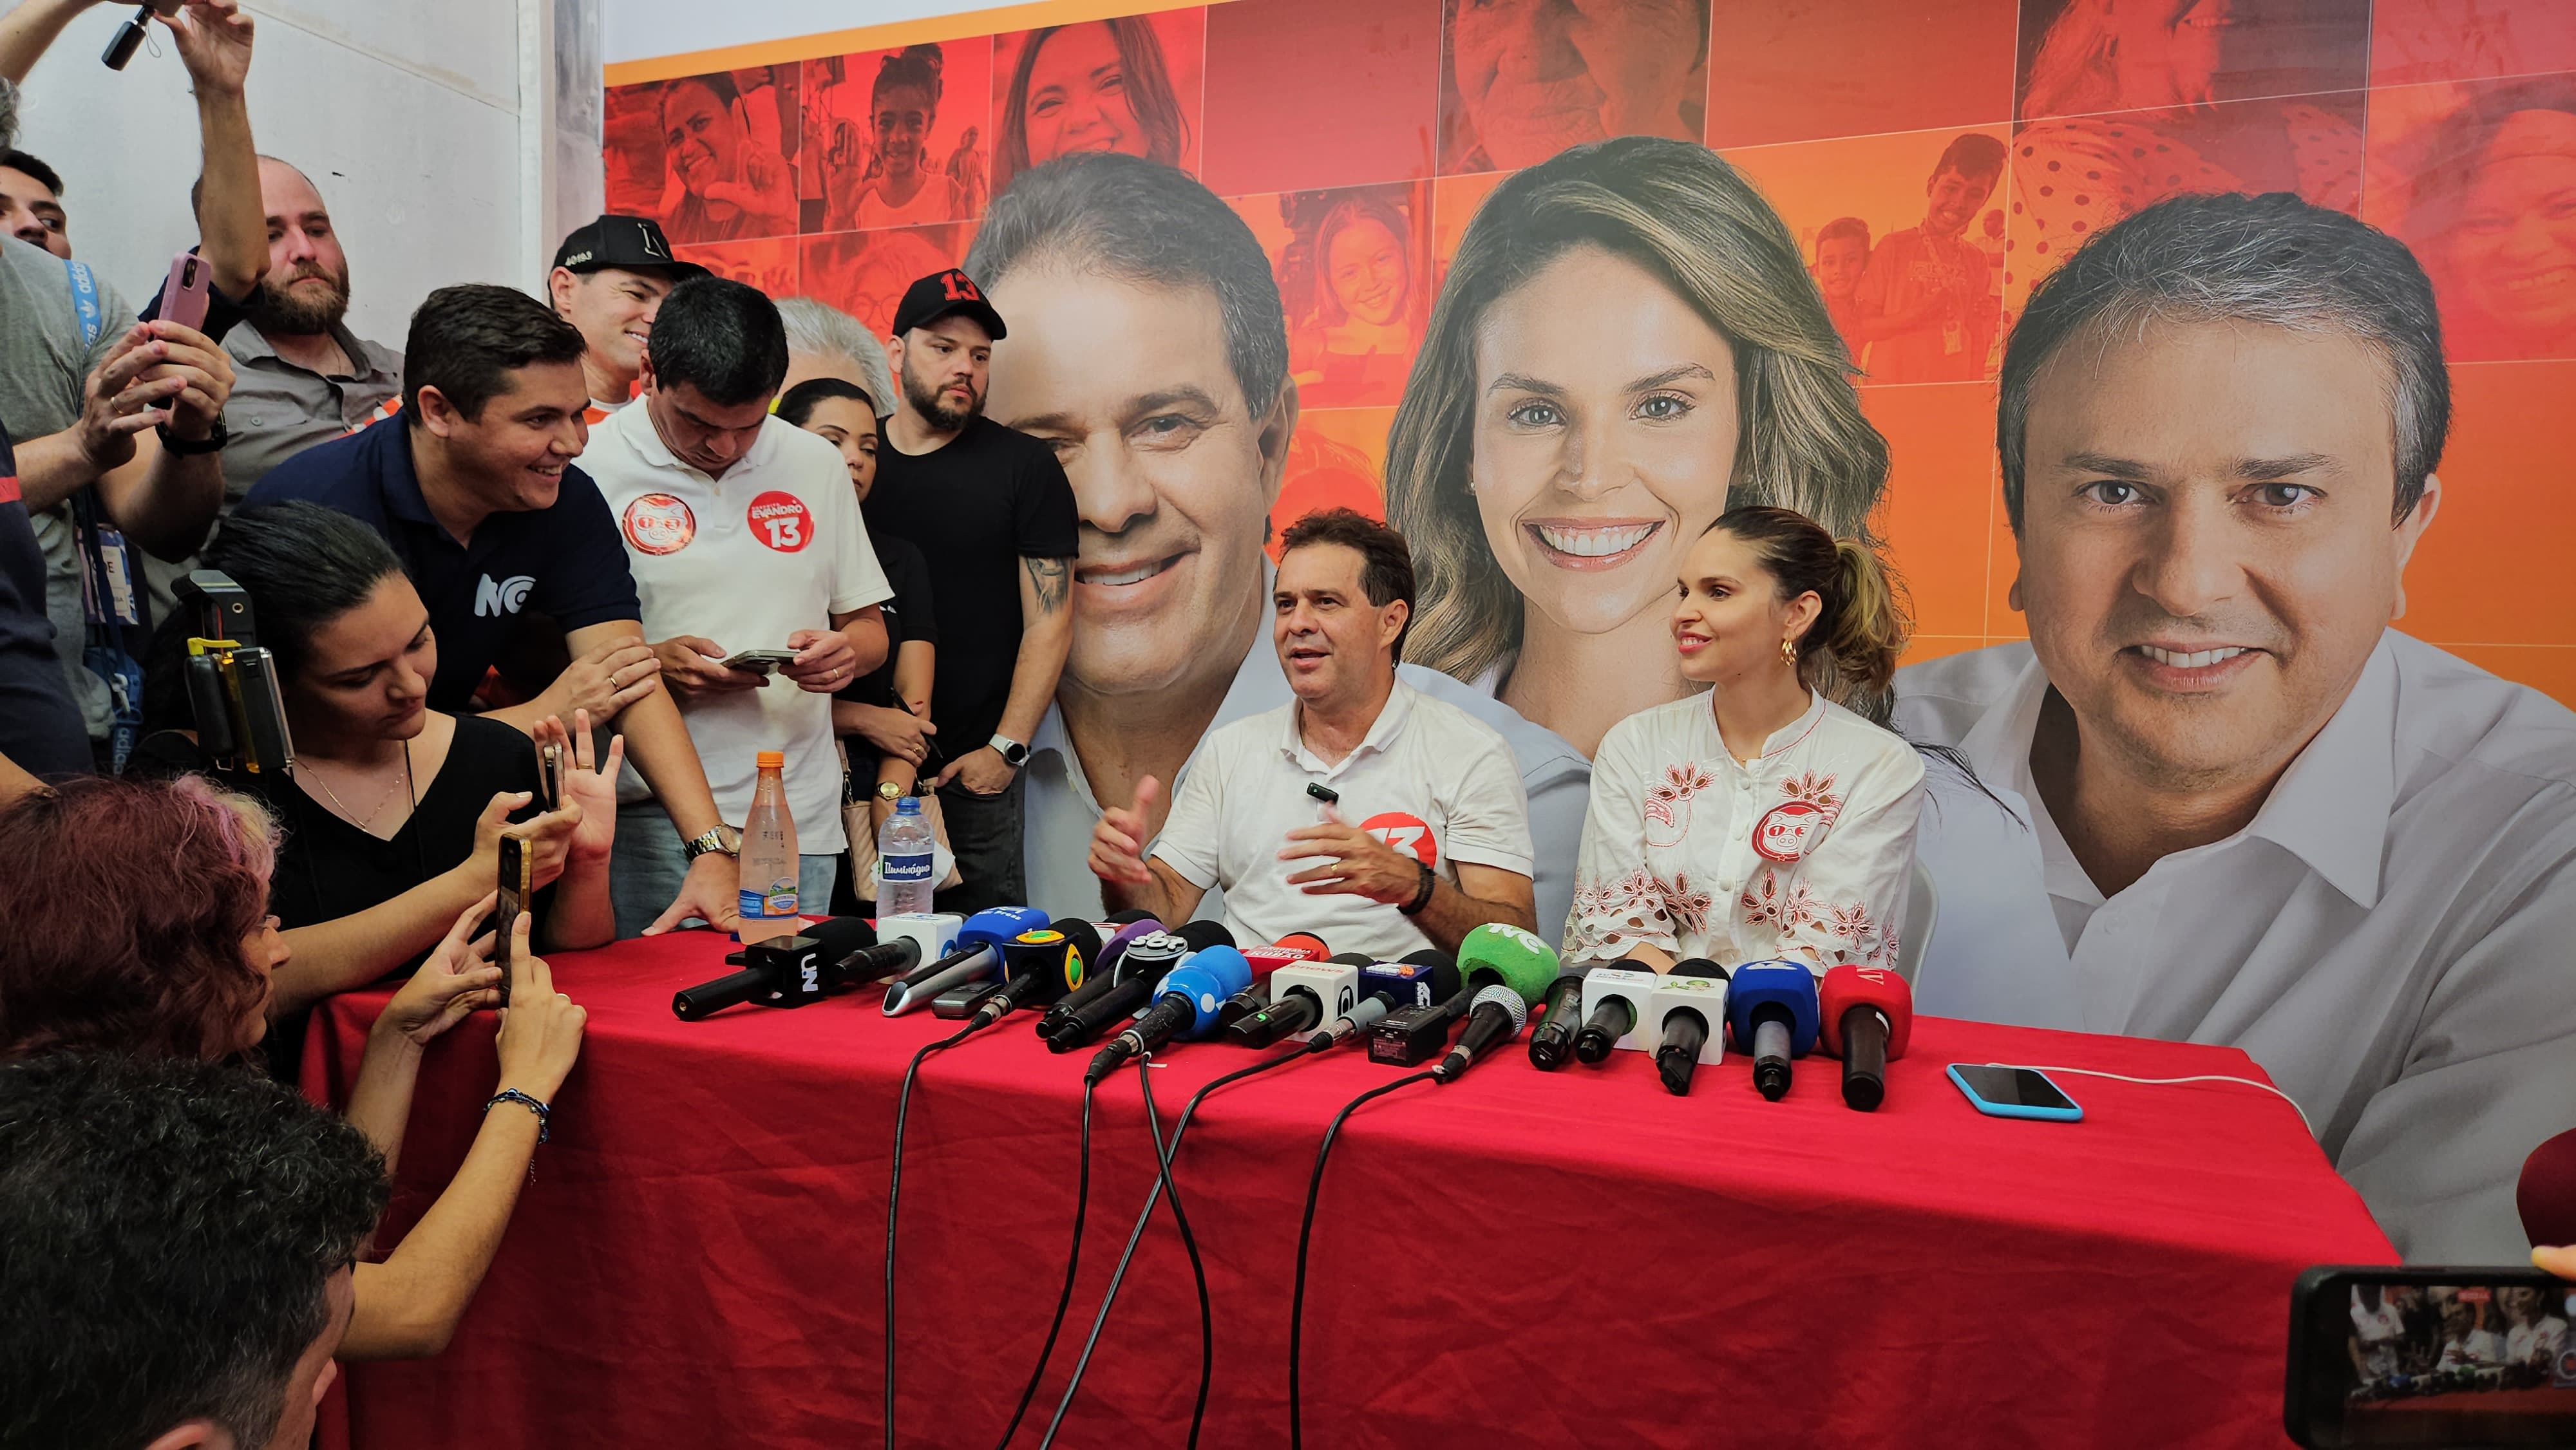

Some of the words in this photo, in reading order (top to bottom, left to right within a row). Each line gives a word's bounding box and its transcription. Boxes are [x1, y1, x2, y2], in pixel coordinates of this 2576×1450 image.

[940, 272, 980, 301] 13
[752, 504, 804, 519] EVANDRO
[764, 516, 802, 549] 13
[884, 862, 931, 876] Iluminágua
